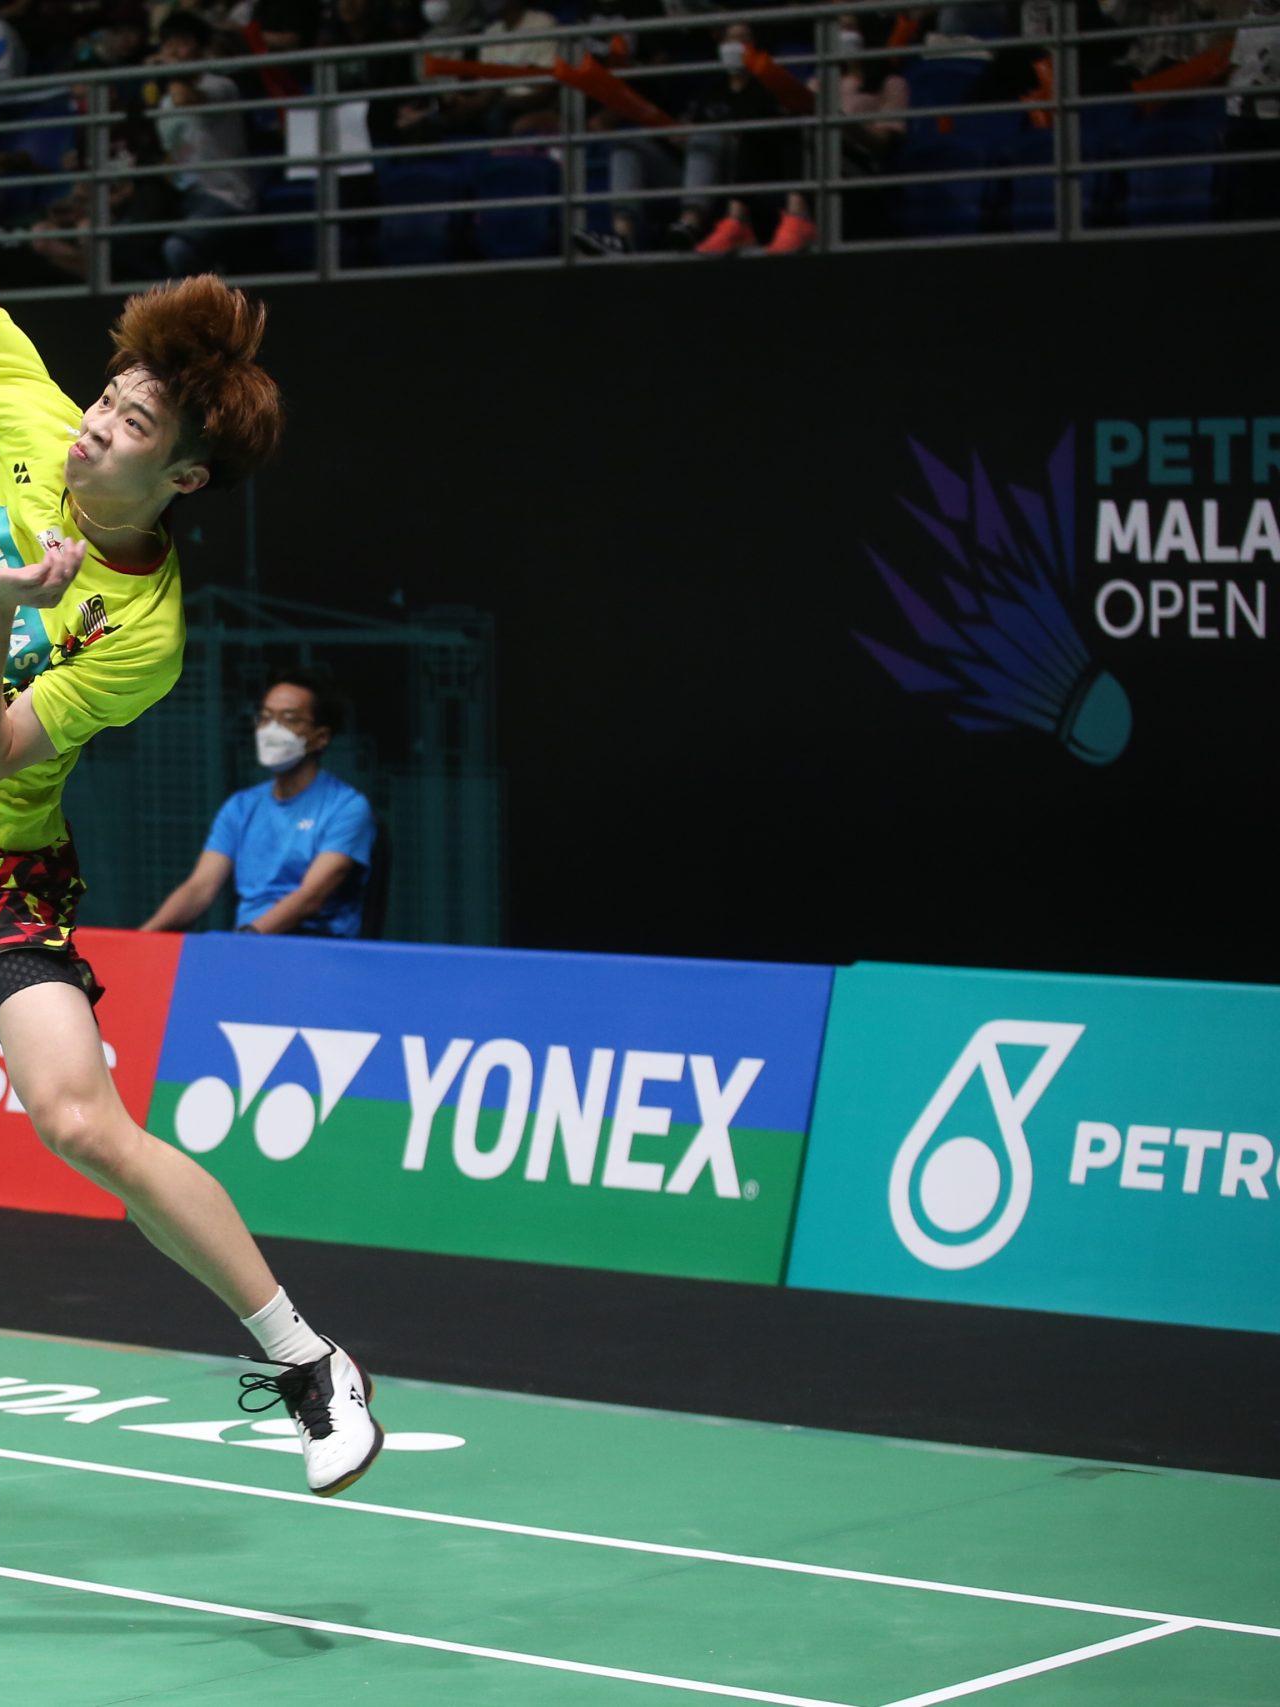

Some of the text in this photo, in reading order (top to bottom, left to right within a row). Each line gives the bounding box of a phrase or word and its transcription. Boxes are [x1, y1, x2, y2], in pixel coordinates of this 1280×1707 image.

[1095, 498, 1280, 563] MALA
[1094, 579, 1267, 640] OPEN
[402, 1035, 765, 1199] YONEX
[1069, 1121, 1280, 1199] PETR
